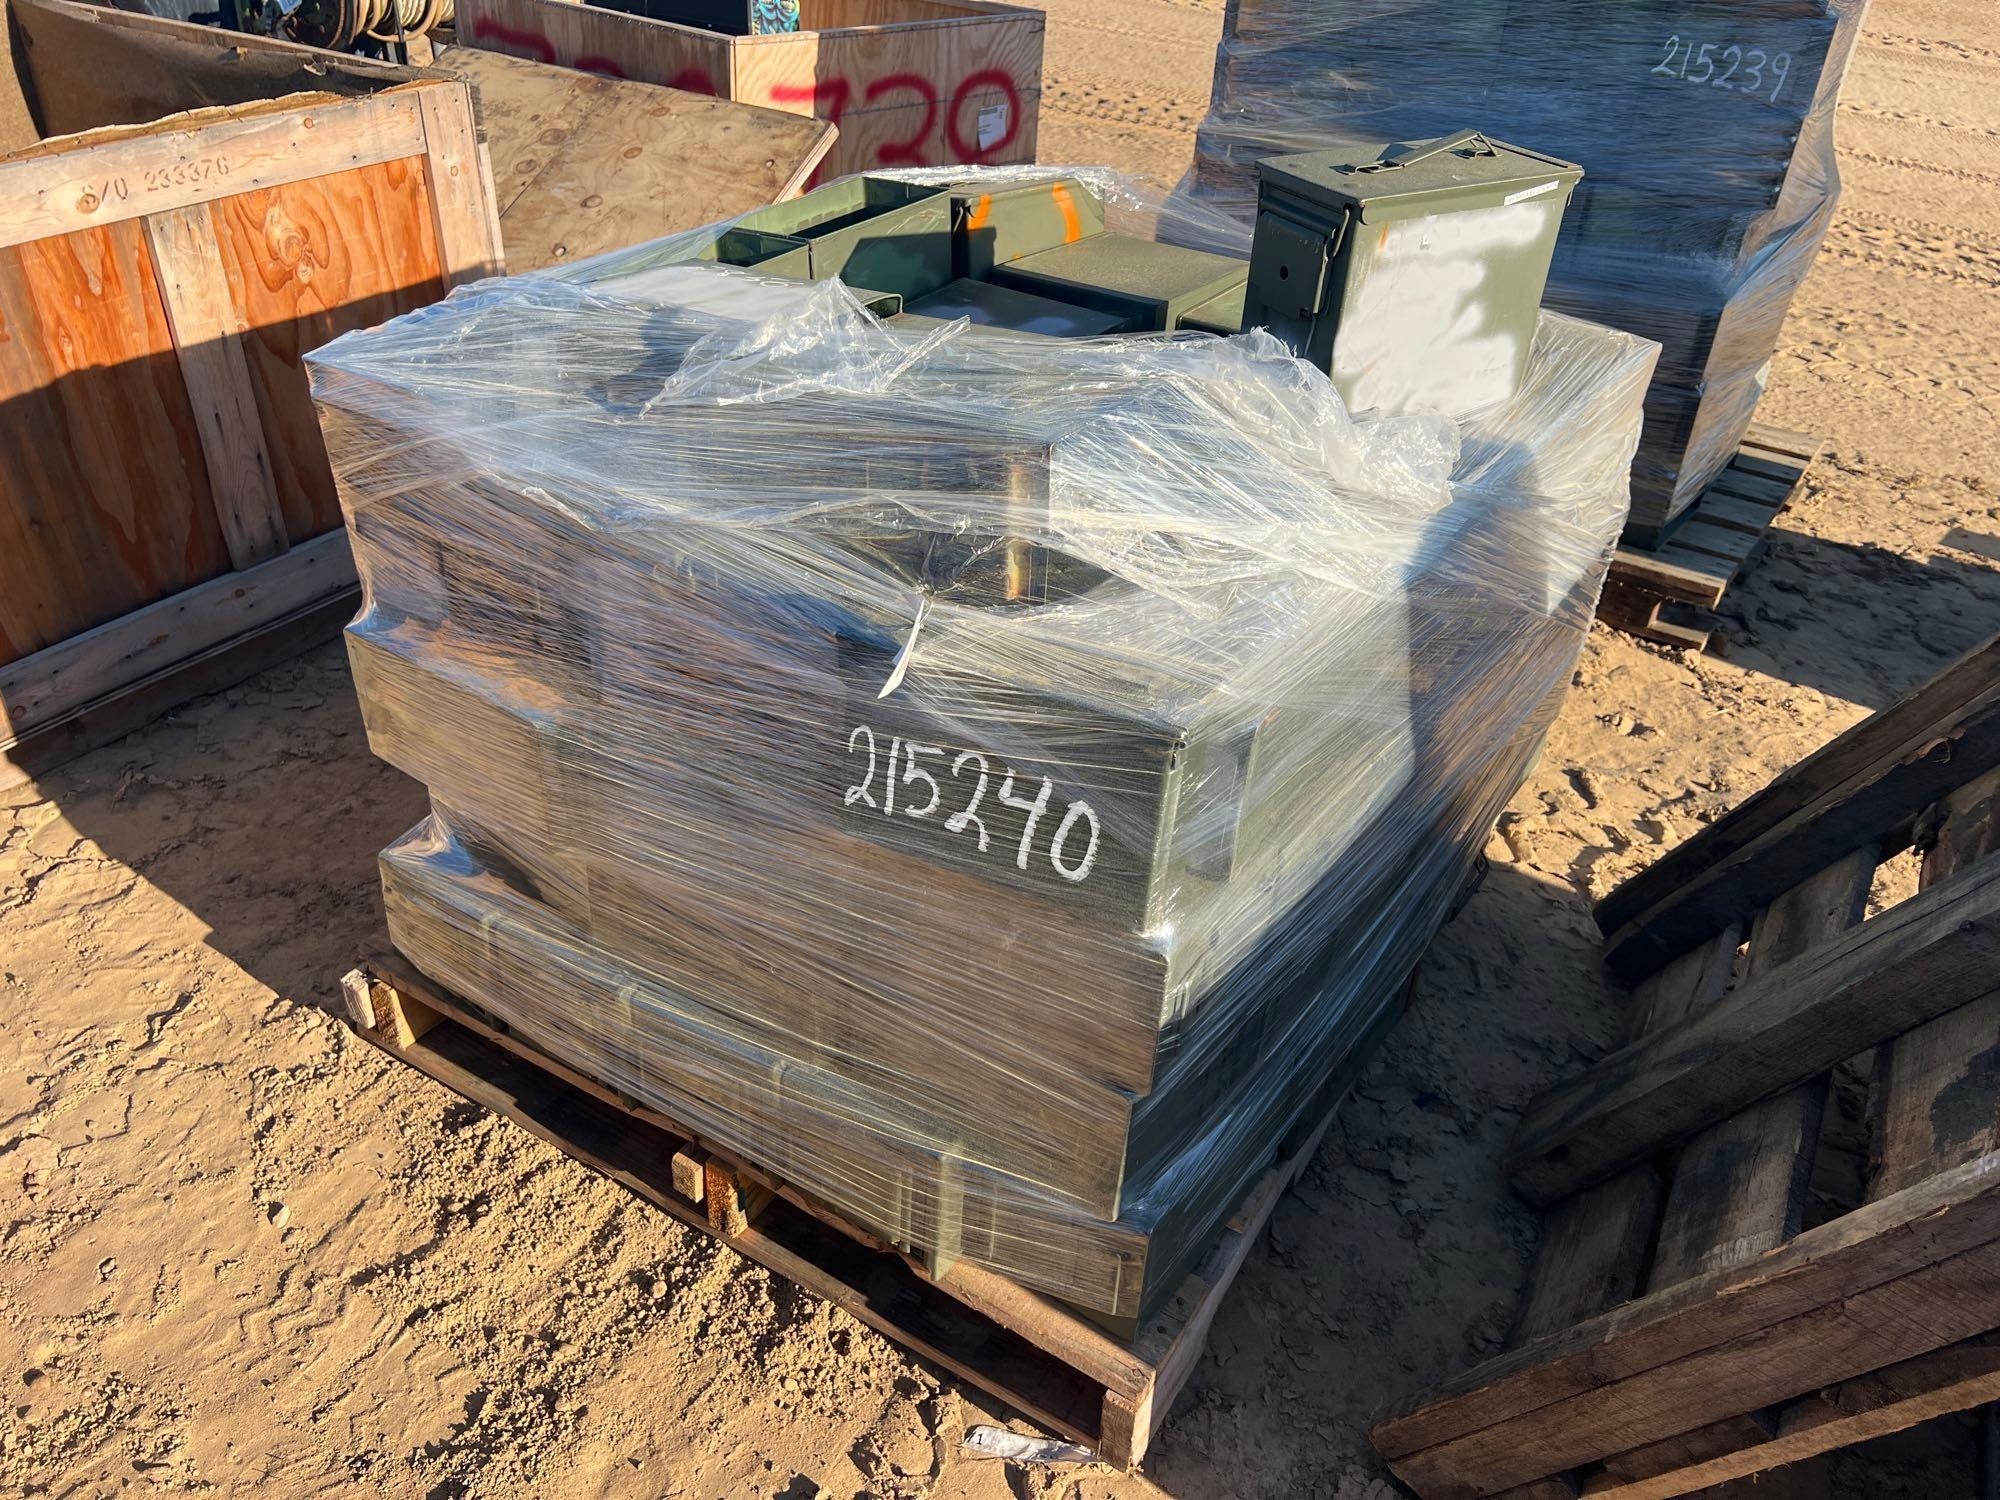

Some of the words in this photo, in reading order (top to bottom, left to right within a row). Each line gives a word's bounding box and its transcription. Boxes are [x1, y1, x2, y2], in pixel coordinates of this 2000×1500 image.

[1650, 34, 1792, 103] 215239
[144, 156, 229, 192] 233376
[769, 67, 1022, 193] 720
[844, 724, 1101, 882] 215240
